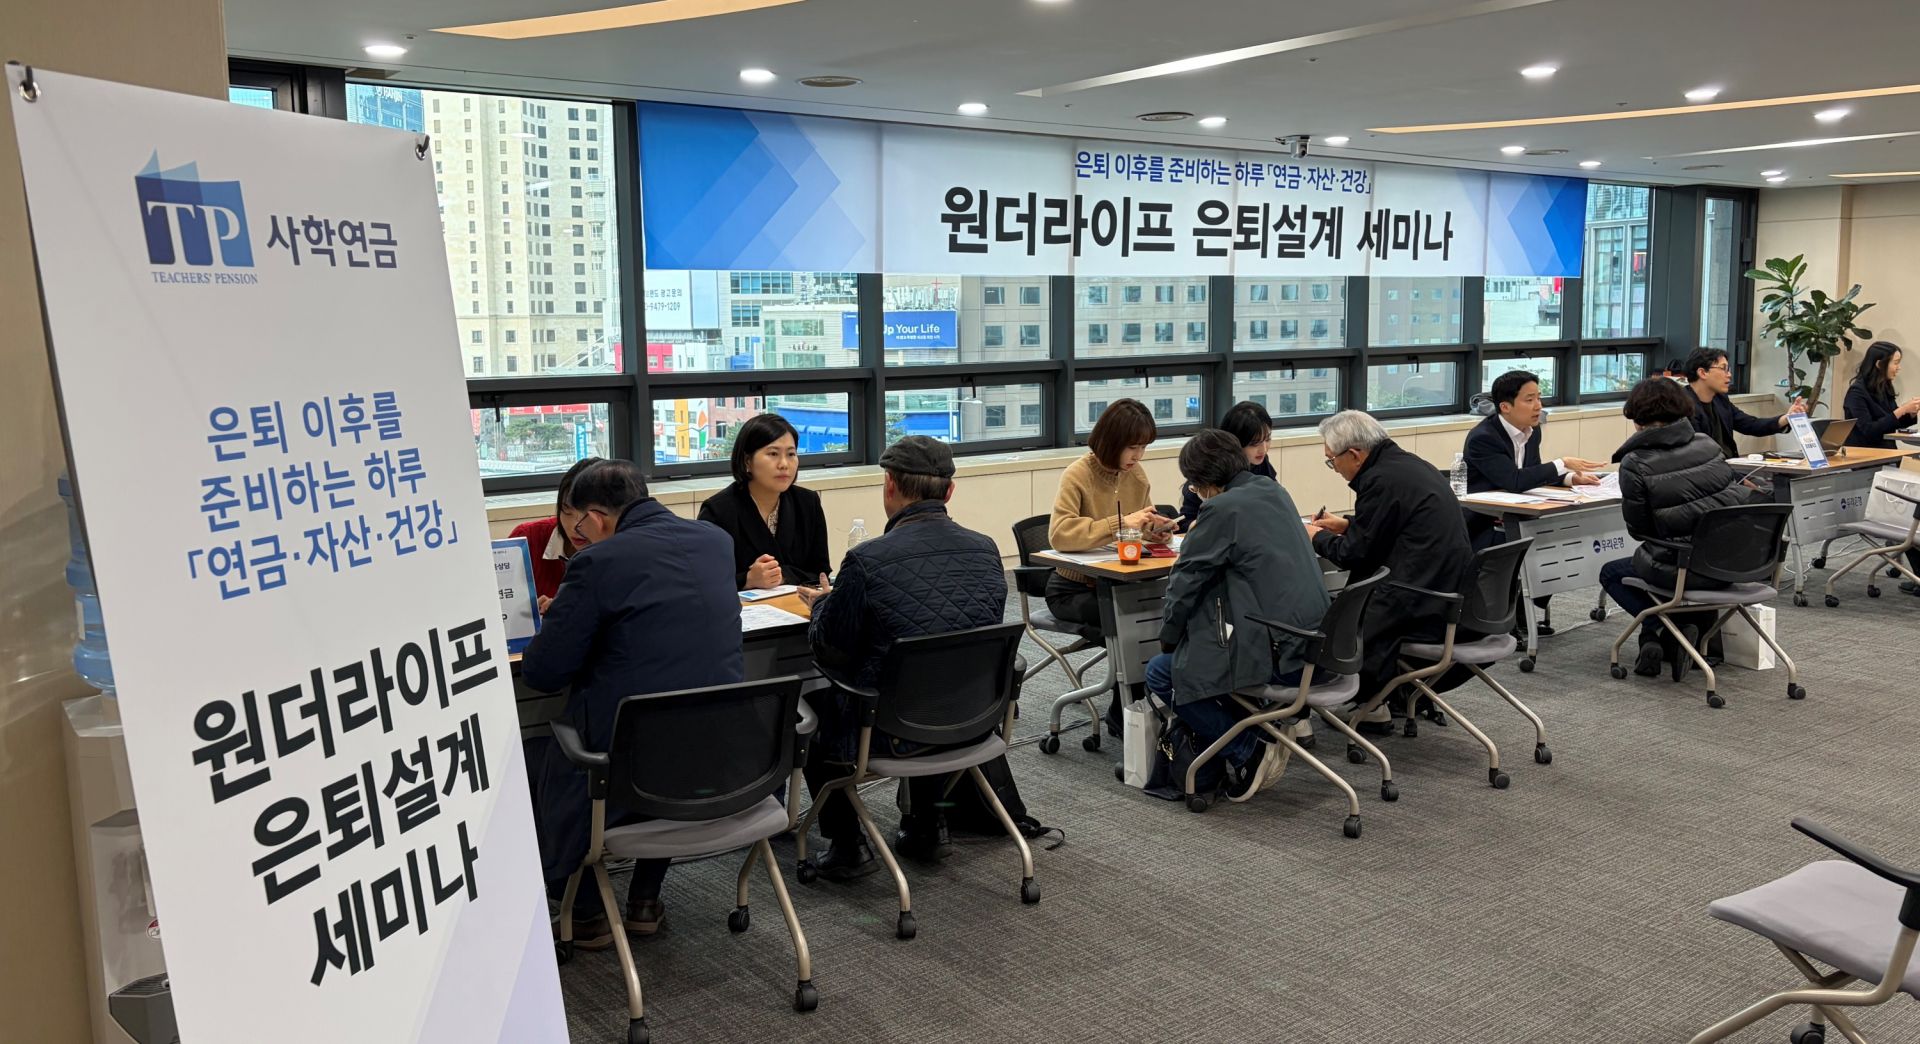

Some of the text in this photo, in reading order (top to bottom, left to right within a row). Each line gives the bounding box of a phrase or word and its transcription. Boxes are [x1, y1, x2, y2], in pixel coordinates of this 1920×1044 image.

[1075, 151, 1109, 180] 은퇴
[1115, 153, 1164, 183] 이후를
[1168, 158, 1232, 186] 준비하는
[1235, 161, 1264, 188] 하루
[145, 200, 241, 267] TP
[266, 214, 398, 269] 사학연금
[940, 186, 1454, 262] 원더라이프 은퇴설계 세미나
[151, 271, 259, 285] TEACHERS' PENSION
[896, 324, 919, 334] Your
[920, 323, 940, 334] Life
[207, 391, 402, 462] 은퇴 이후를
[200, 448, 427, 532] 준비하는 하루
[1602, 537, 1625, 551] 우리은행
[191, 617, 499, 805] 원더라이프
[250, 713, 490, 906] 은퇴설계
[310, 820, 480, 987] 세미나
